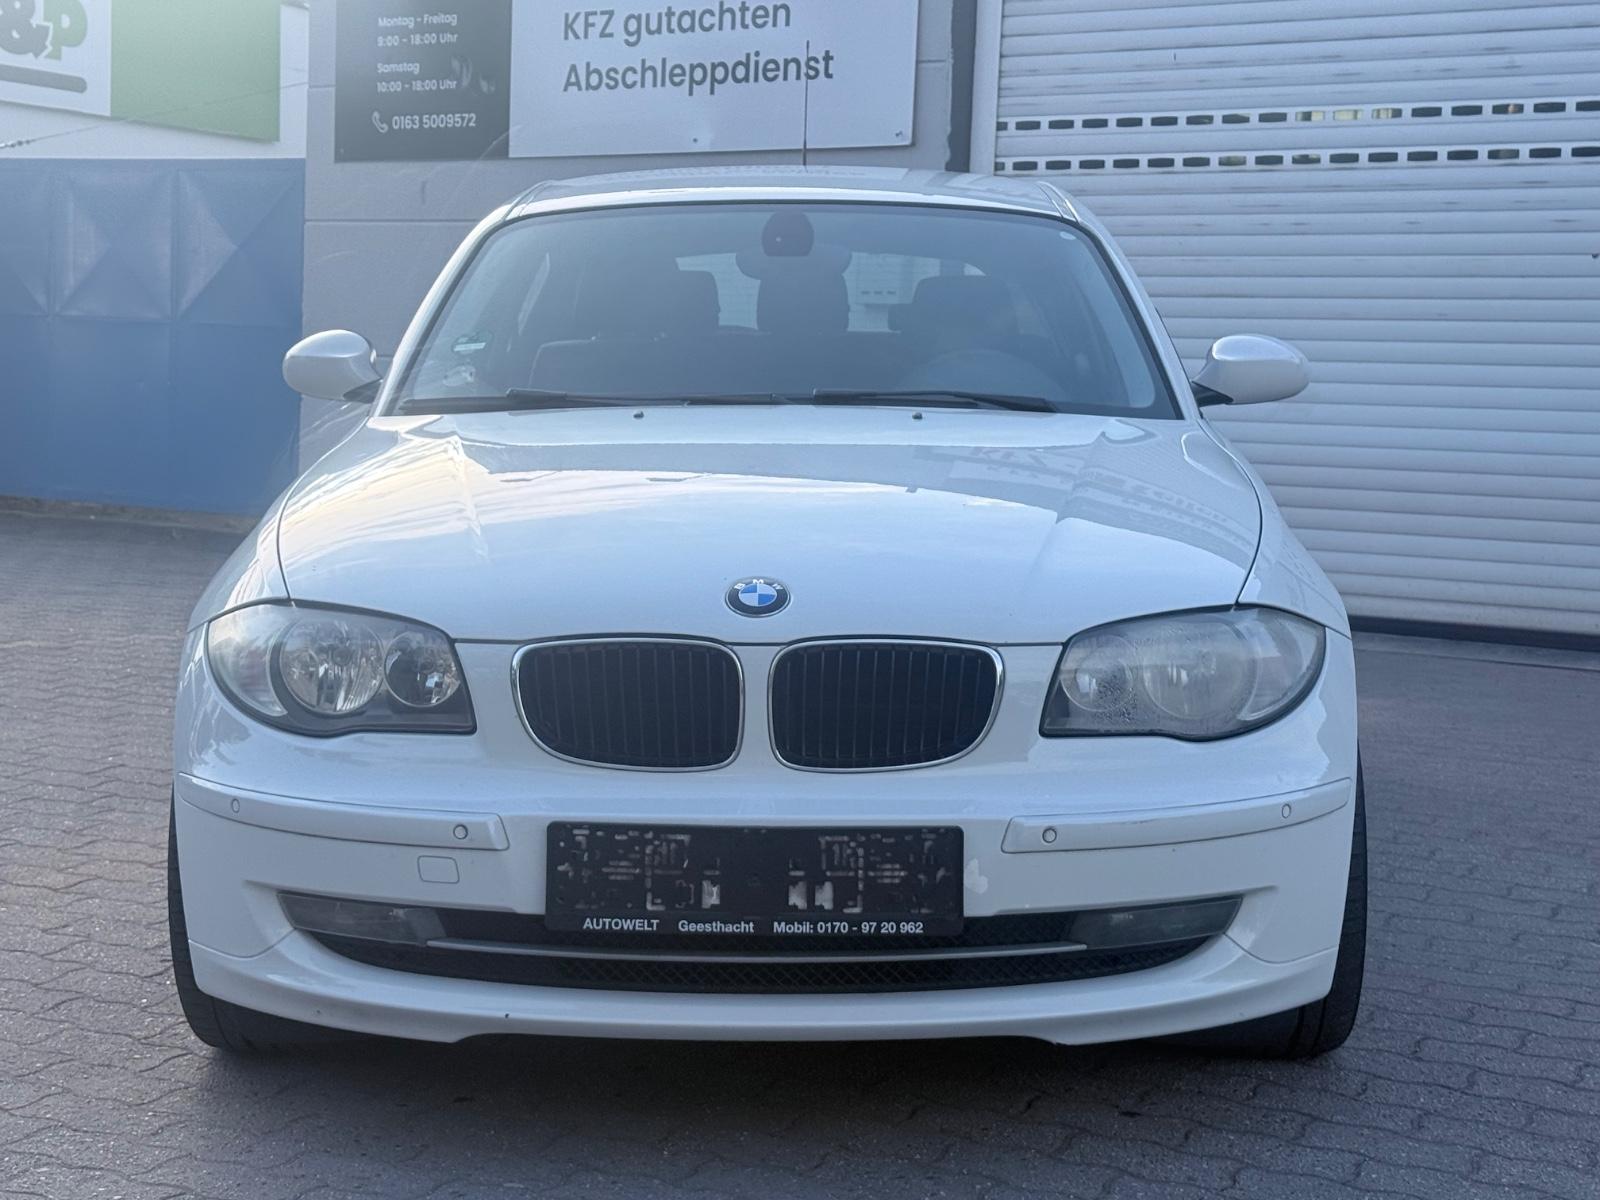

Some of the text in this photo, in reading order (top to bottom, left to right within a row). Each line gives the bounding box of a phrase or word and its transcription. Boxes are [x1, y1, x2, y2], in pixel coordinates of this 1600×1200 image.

[378, 16, 415, 29] Montag
[423, 13, 458, 26] Freitag
[563, 1, 791, 47] KFZ gutachten
[439, 33, 458, 44] Uhr
[377, 62, 420, 75] Samstag
[562, 50, 834, 97] Abschleppdienst
[377, 81, 402, 92] 10:00
[439, 79, 457, 90] Uhr
[392, 113, 477, 130] 0163 5009572
[582, 918, 660, 931] AUTOWELT
[678, 920, 755, 933] Geesthacht
[773, 921, 814, 934] Mobil:
[817, 922, 849, 934] 0170
[861, 922, 877, 934] 97
[880, 922, 897, 934] 20
[899, 922, 924, 934] 962
